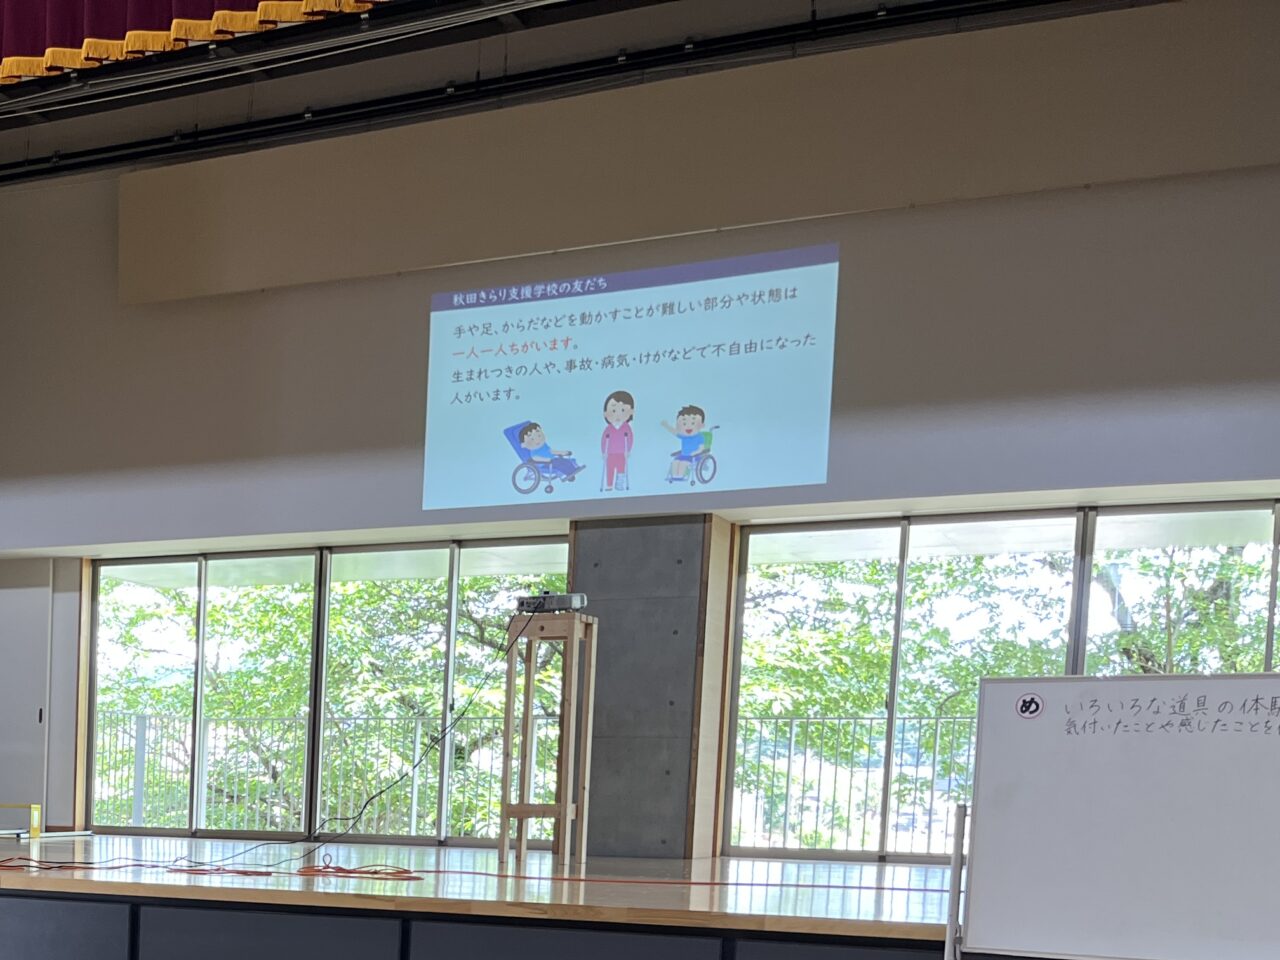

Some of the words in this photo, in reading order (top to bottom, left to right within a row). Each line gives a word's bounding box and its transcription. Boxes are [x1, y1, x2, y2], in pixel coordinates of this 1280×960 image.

[452, 277, 608, 306] 秋田きらり支援学校の友だち
[453, 286, 798, 338] 手や足、からだなどを動かすことが難しい部分や状態は
[451, 332, 817, 383] 生まれつきの人や、事故・病気・けがなどで不自由になった
[452, 336, 578, 360] 一人一人ちがいます。
[450, 386, 521, 405] 人がいます。
[1019, 697, 1040, 715] め
